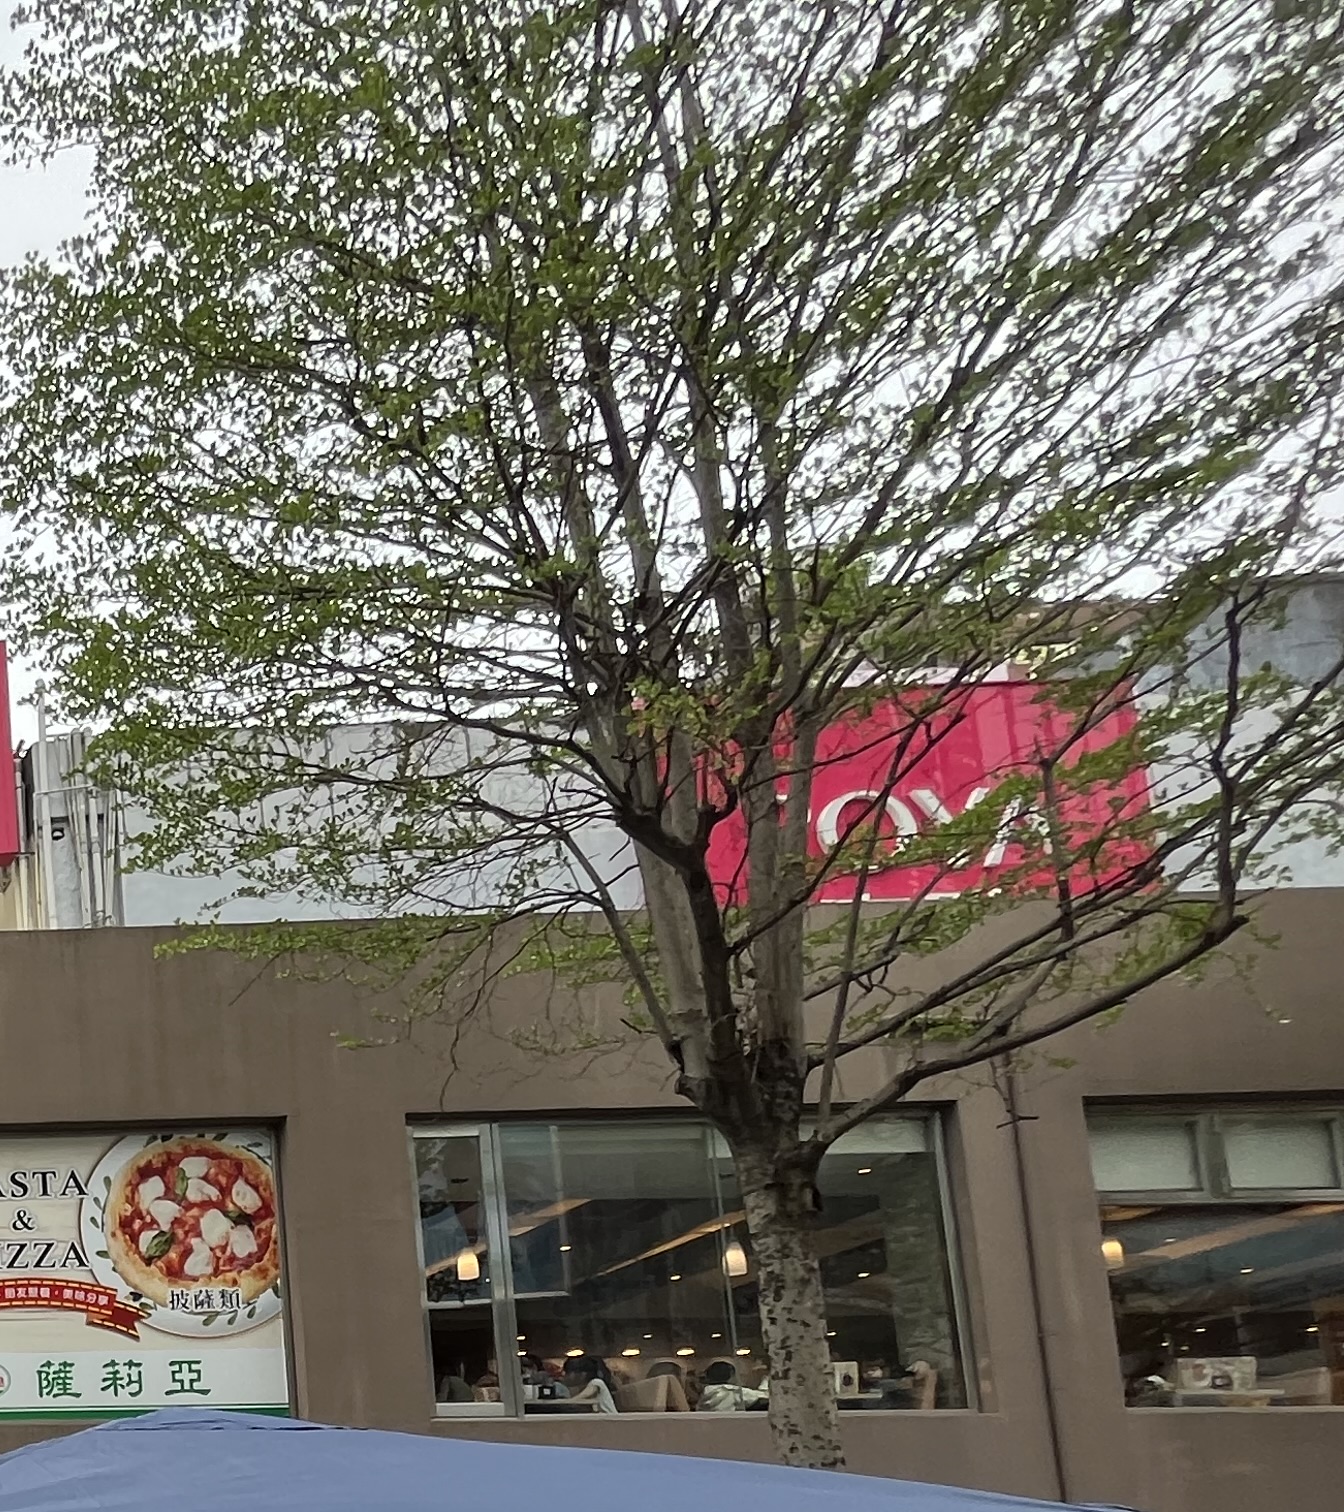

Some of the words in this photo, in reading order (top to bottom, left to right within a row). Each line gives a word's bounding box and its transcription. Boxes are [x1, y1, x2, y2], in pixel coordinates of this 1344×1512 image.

[11, 1210, 35, 1232] &
[169, 1288, 242, 1310] 披薩類
[36, 1359, 212, 1399] 薩莉亞
